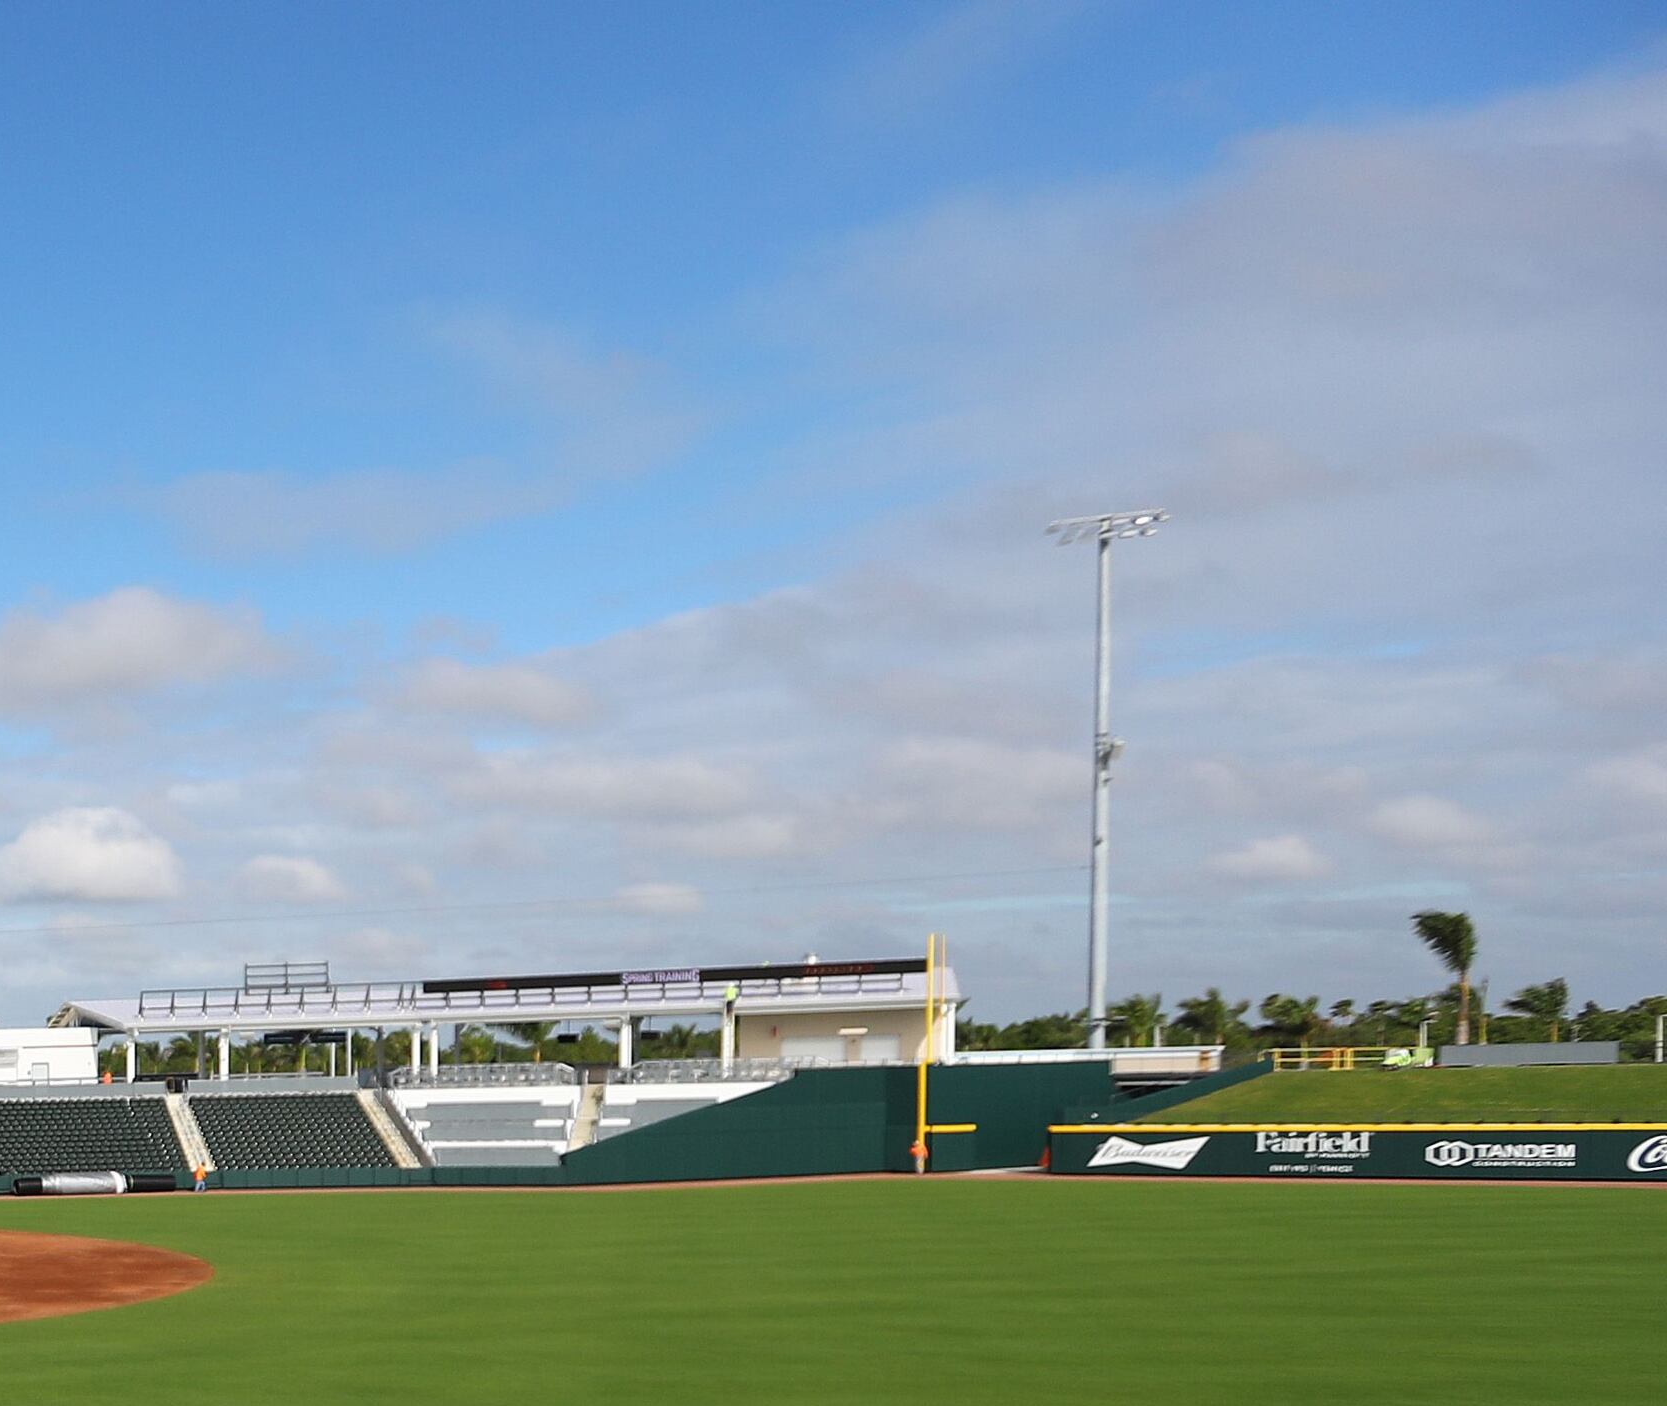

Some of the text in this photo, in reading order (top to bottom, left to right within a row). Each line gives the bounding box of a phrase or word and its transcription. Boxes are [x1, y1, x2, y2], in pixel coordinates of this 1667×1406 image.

[622, 968, 700, 984] SPRING TRAINING
[1255, 1131, 1370, 1153] Fairfield
[1473, 1143, 1576, 1158] TANDEM
